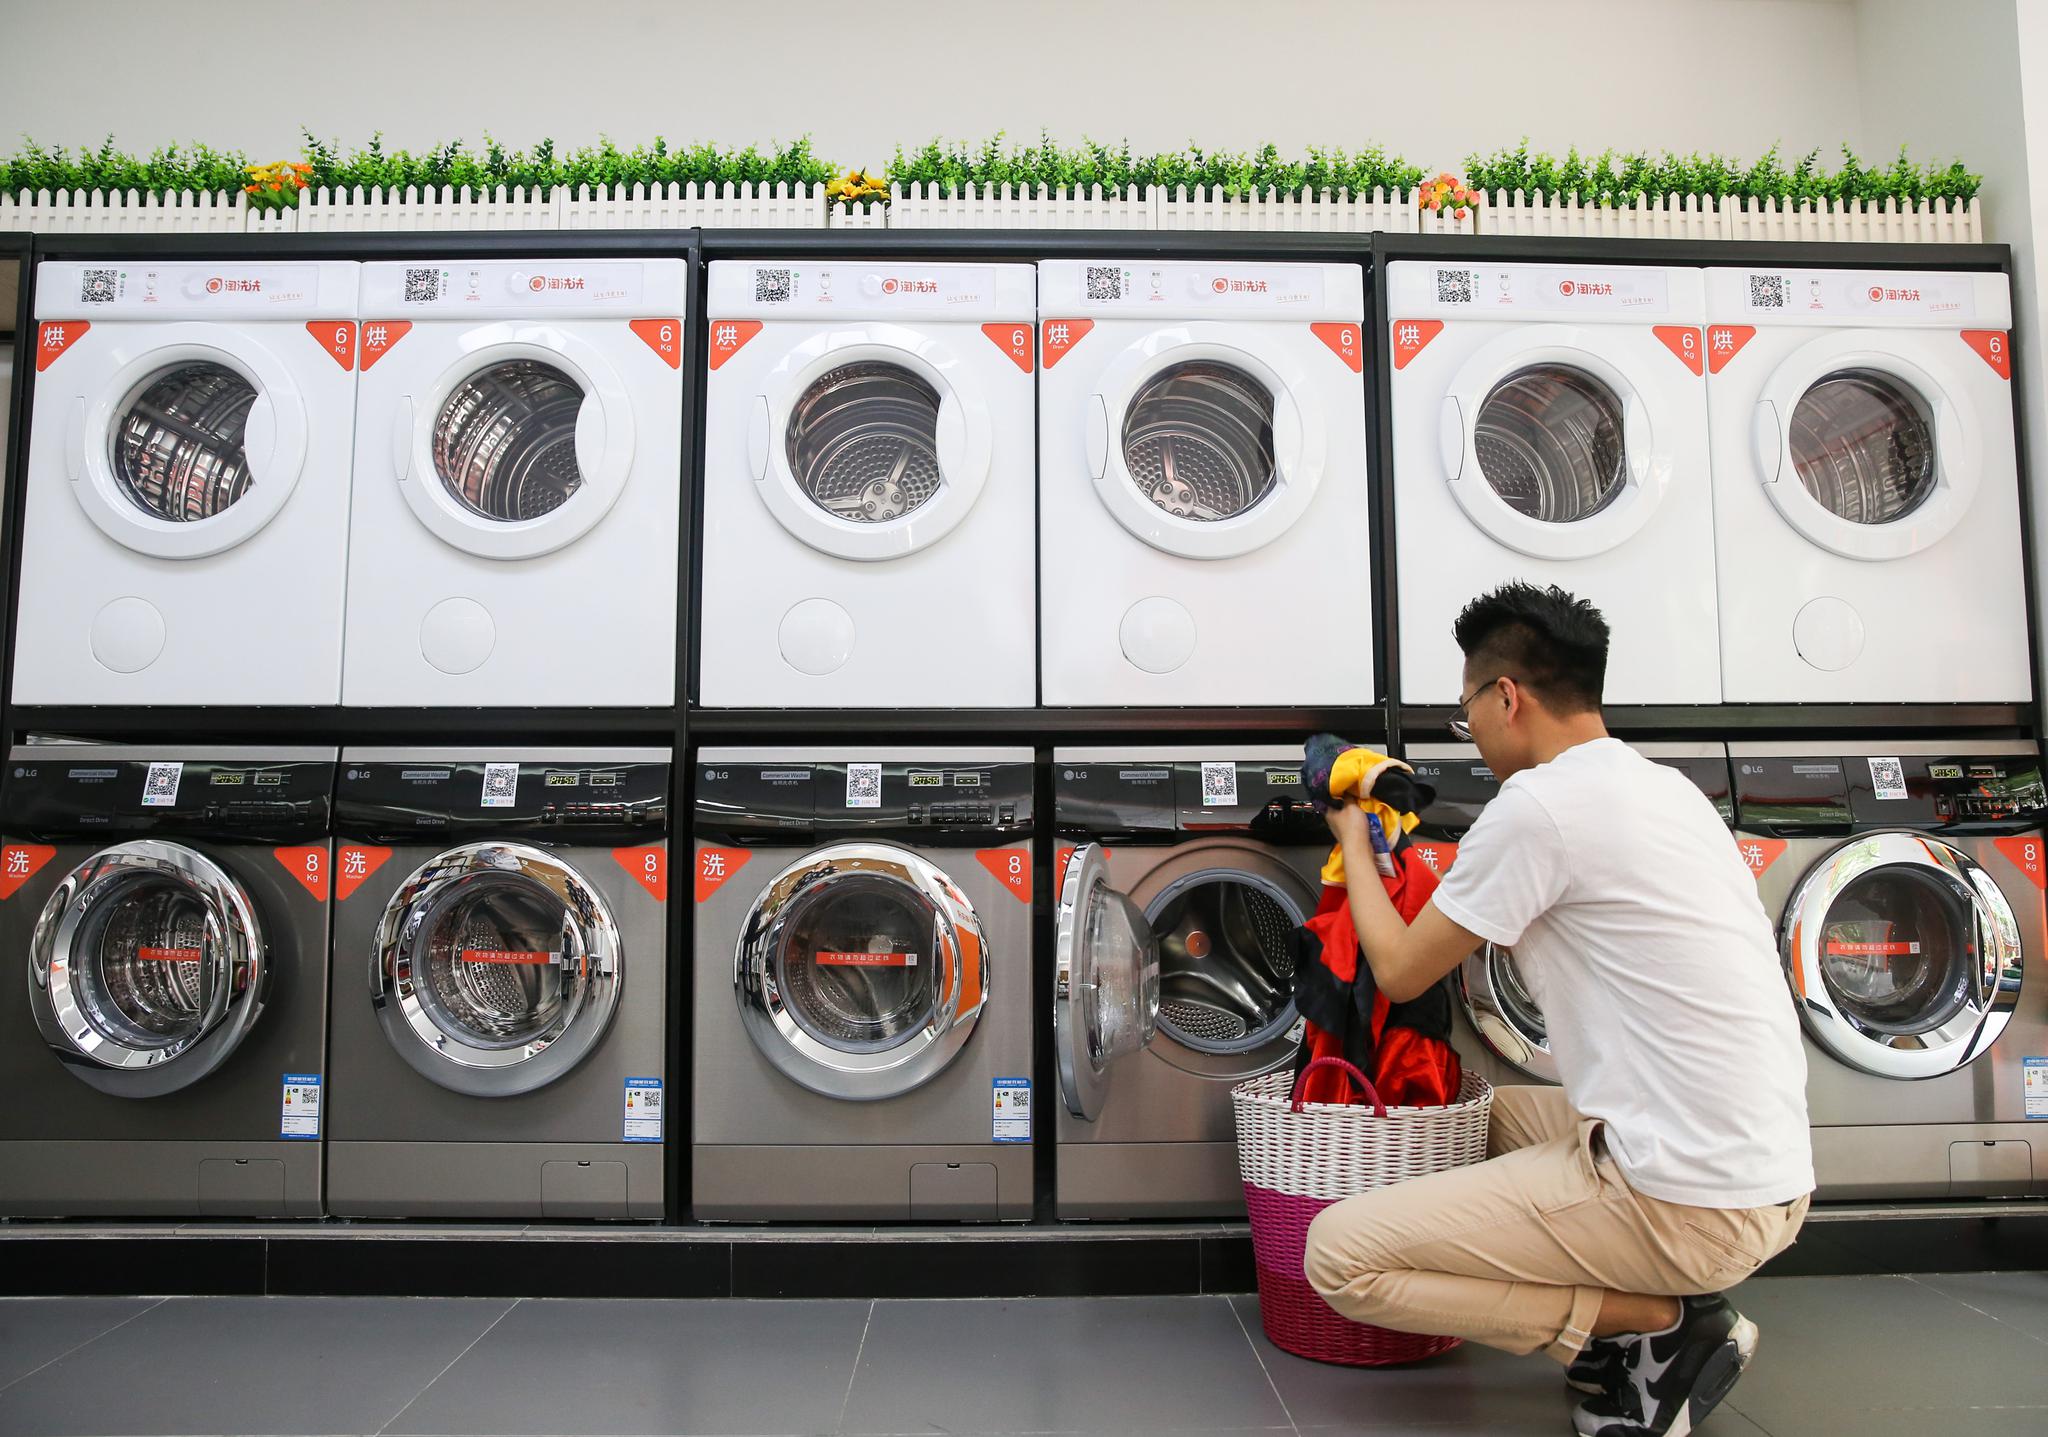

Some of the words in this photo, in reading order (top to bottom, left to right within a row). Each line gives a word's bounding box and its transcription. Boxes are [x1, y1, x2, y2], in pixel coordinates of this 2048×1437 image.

[44, 326, 65, 347] 烘
[335, 327, 347, 344] 6
[366, 326, 387, 347] 烘
[659, 325, 672, 342] 6
[716, 325, 738, 346] 烘
[1012, 329, 1025, 347] 6
[1048, 324, 1070, 345] 烘
[1341, 329, 1353, 346] 6
[1399, 325, 1420, 345] 烘
[1682, 332, 1694, 348] 6
[1713, 330, 1733, 350] 烘
[335, 346, 346, 354] Kg
[660, 344, 672, 352] Kg
[1013, 348, 1025, 357] Kg
[1342, 347, 1353, 356] Kg
[1989, 337, 2001, 353] 6
[1683, 351, 1695, 360] Kg
[1990, 355, 2002, 363] Kg
[25, 769, 37, 777] LG
[359, 771, 371, 779] LG
[2024, 843, 2036, 861] 8
[8, 851, 29, 873] 洗
[306, 853, 319, 872] 8
[344, 851, 366, 874] 洗
[644, 853, 657, 872] 8
[703, 853, 725, 876] 洗
[1008, 855, 1021, 874] 8
[2025, 863, 2037, 872] Kg
[306, 874, 319, 883] Kg
[645, 874, 657, 883] Kg
[1009, 876, 1022, 885] Kg
